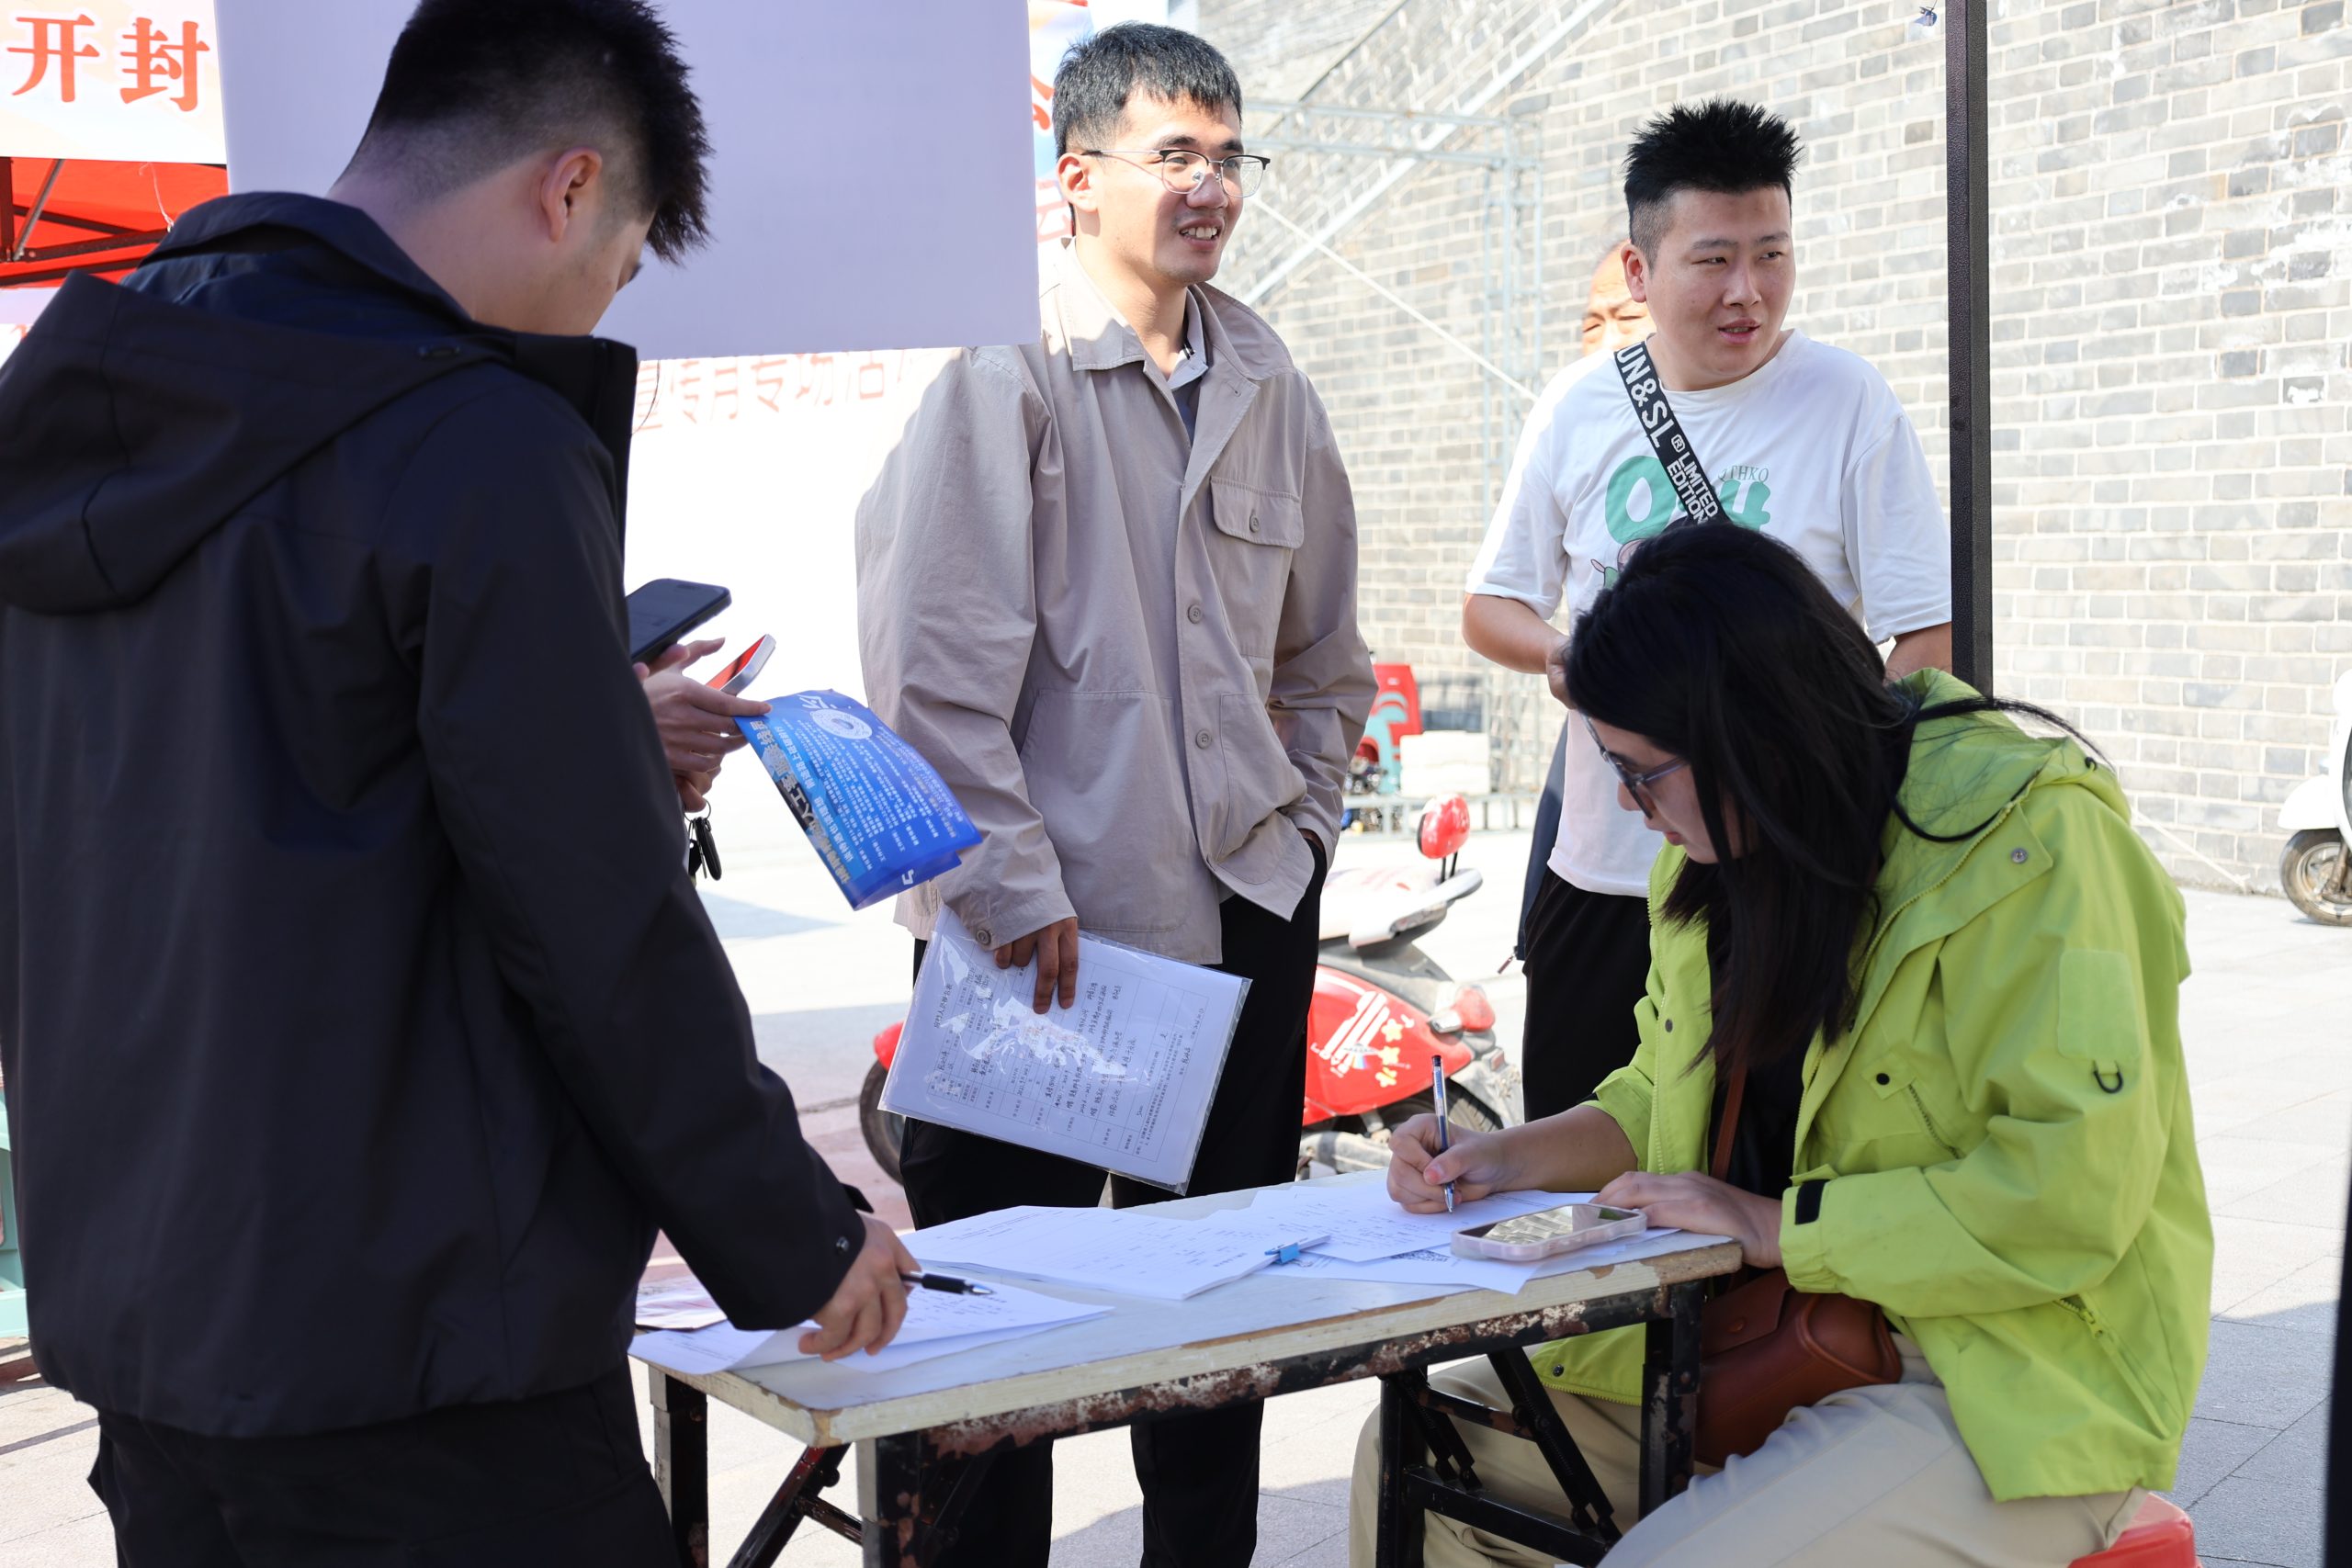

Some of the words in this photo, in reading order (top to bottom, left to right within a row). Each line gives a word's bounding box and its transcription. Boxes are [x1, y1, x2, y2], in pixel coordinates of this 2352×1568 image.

[6, 14, 209, 112] 开封
[1667, 461, 1708, 525] EDITION
[1675, 453, 1718, 518] LIMITED
